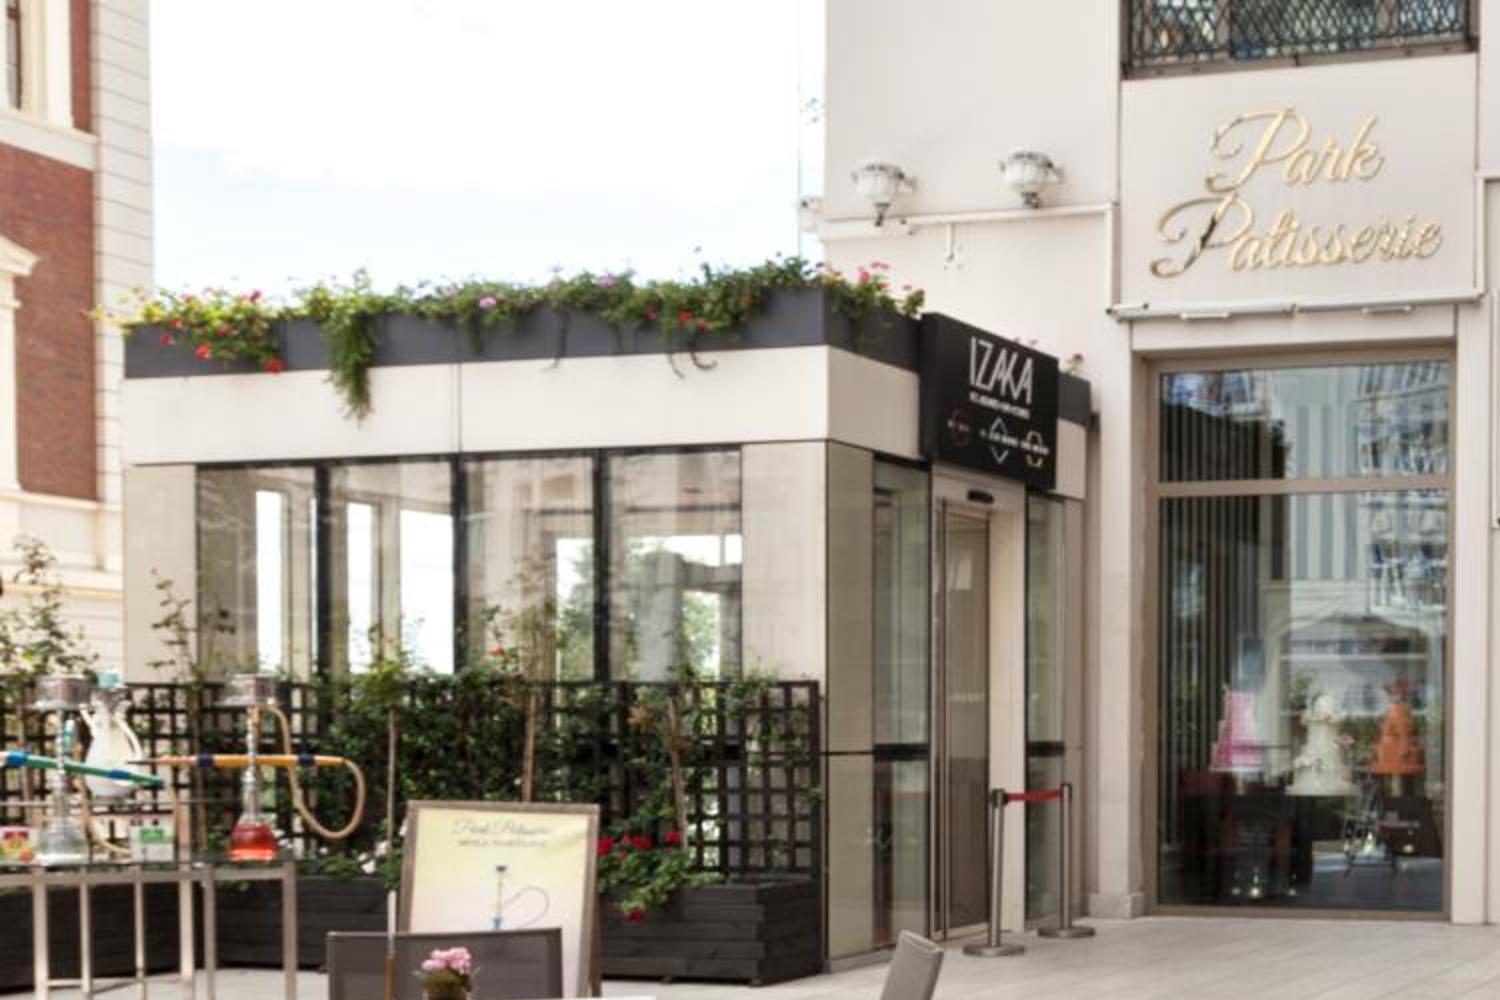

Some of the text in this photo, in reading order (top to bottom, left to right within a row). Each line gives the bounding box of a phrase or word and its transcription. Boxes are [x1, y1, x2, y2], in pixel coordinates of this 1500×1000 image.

[1205, 106, 1386, 194] Park
[1150, 191, 1444, 279] Patisserie
[969, 335, 1034, 405] IZAKA
